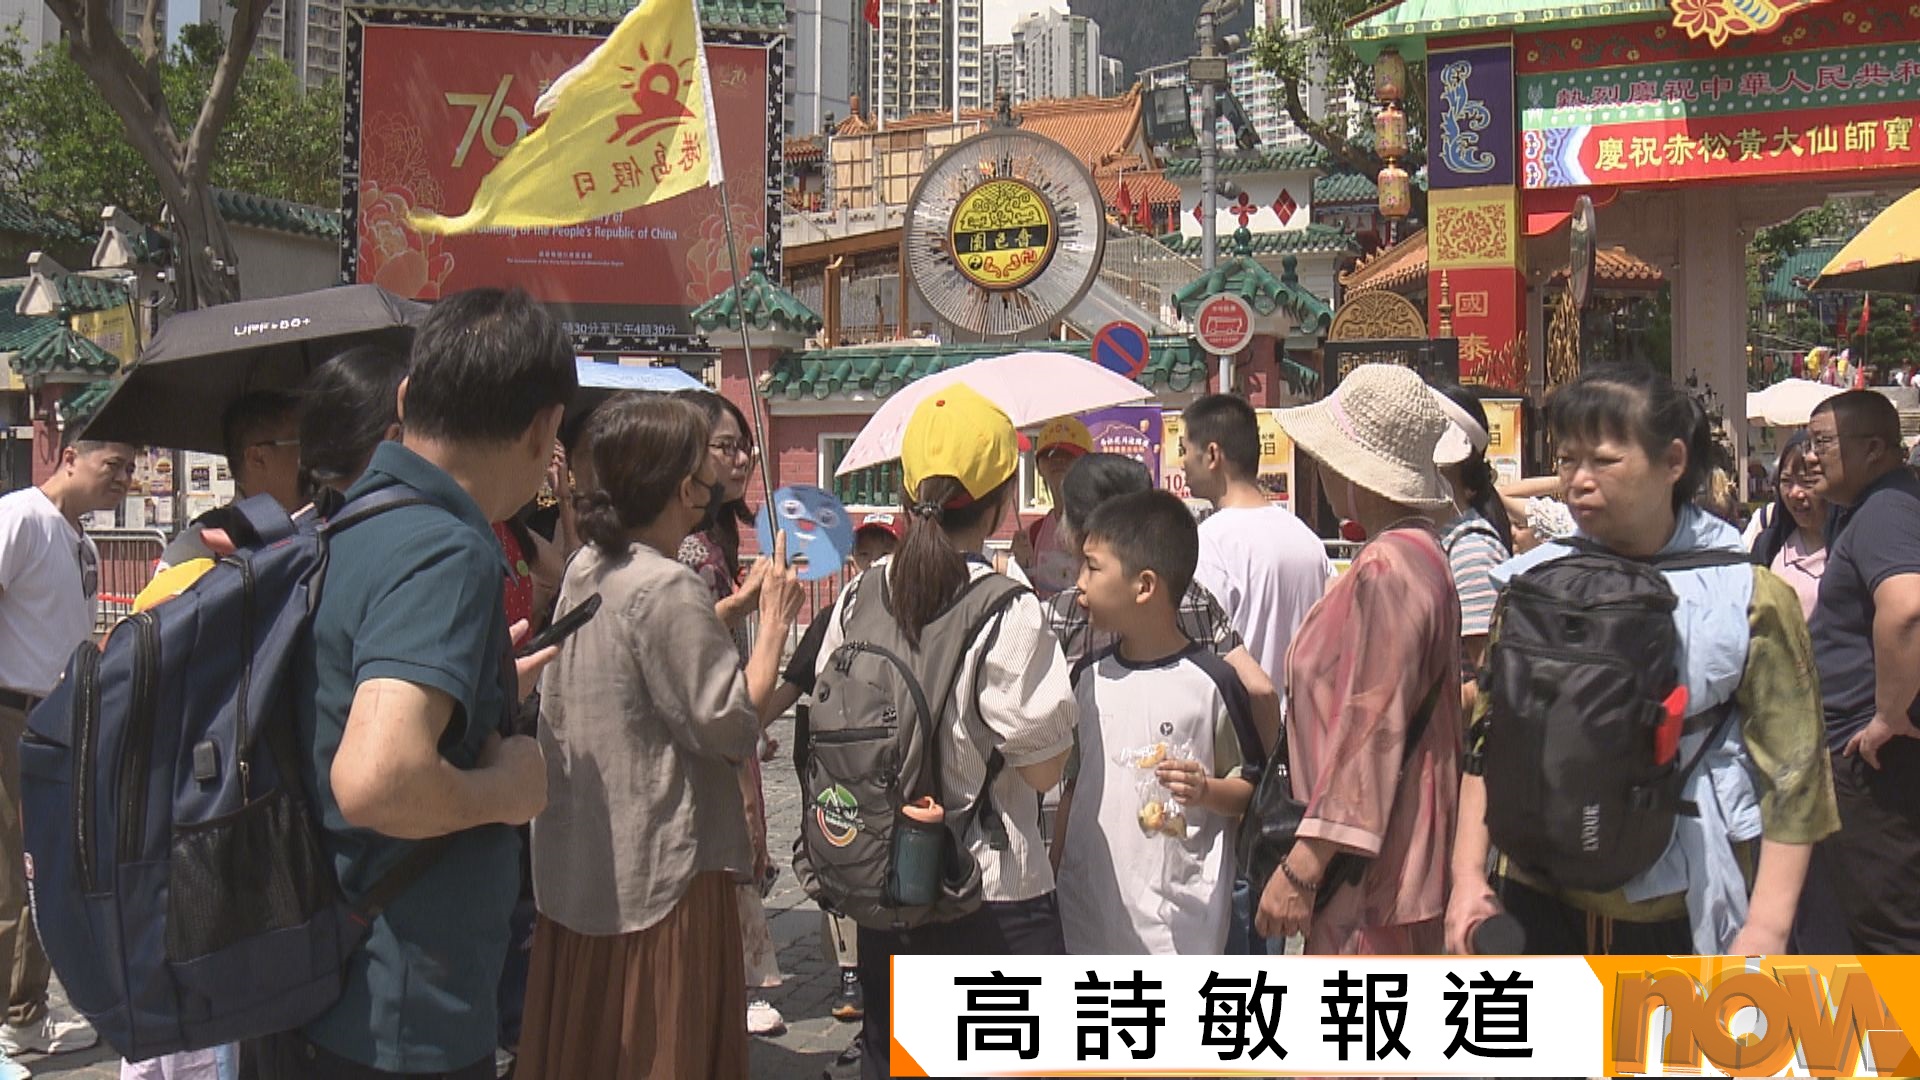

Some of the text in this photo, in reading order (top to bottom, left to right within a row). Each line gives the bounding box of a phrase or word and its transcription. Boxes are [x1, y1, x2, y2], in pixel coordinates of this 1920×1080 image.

[444, 74, 527, 167] 76
[552, 224, 592, 240] People's
[595, 226, 635, 240] Republic
[638, 227, 648, 239] of
[651, 227, 677, 240] China
